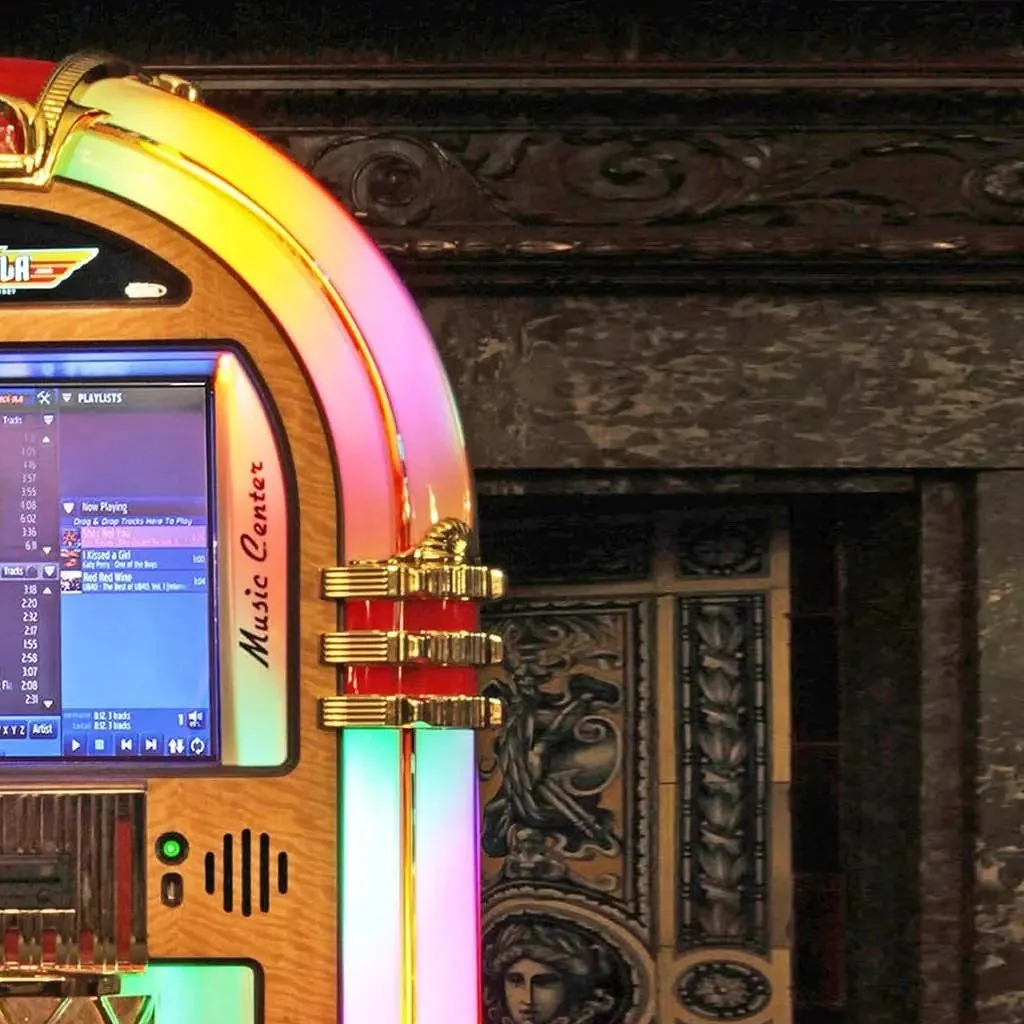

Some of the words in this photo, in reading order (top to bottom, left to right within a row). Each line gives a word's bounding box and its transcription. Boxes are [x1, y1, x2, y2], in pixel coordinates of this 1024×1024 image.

[78, 392, 123, 404] PLAYLISTS
[3, 416, 23, 425] Tracks
[82, 502, 99, 512] Now
[100, 502, 128, 514] Playing
[240, 461, 268, 563] Center
[74, 517, 92, 526] Drag
[101, 517, 119, 526] Drop
[121, 517, 144, 525] Tracks
[145, 517, 163, 525] Here
[165, 517, 175, 525] To
[176, 517, 193, 526] Play
[86, 551, 110, 560] Kissed
[118, 550, 131, 560] Girl
[96, 561, 111, 570] Perry
[115, 561, 126, 569] One
[127, 561, 134, 569] of
[134, 561, 144, 569] the
[4, 566, 24, 576] Tracks
[83, 572, 97, 582] Red
[99, 572, 113, 582] Red
[114, 572, 133, 582] Wine
[103, 582, 113, 591] The
[114, 582, 126, 591] Best
[21, 600, 37, 608] 2:20
[23, 612, 37, 622] 2:32
[239, 574, 269, 669] Music
[22, 654, 37, 662] 2:58
[23, 666, 37, 676] 3:07
[21, 680, 37, 690] 2:08
[25, 694, 38, 704] 2:31
[33, 724, 53, 734] Artist
